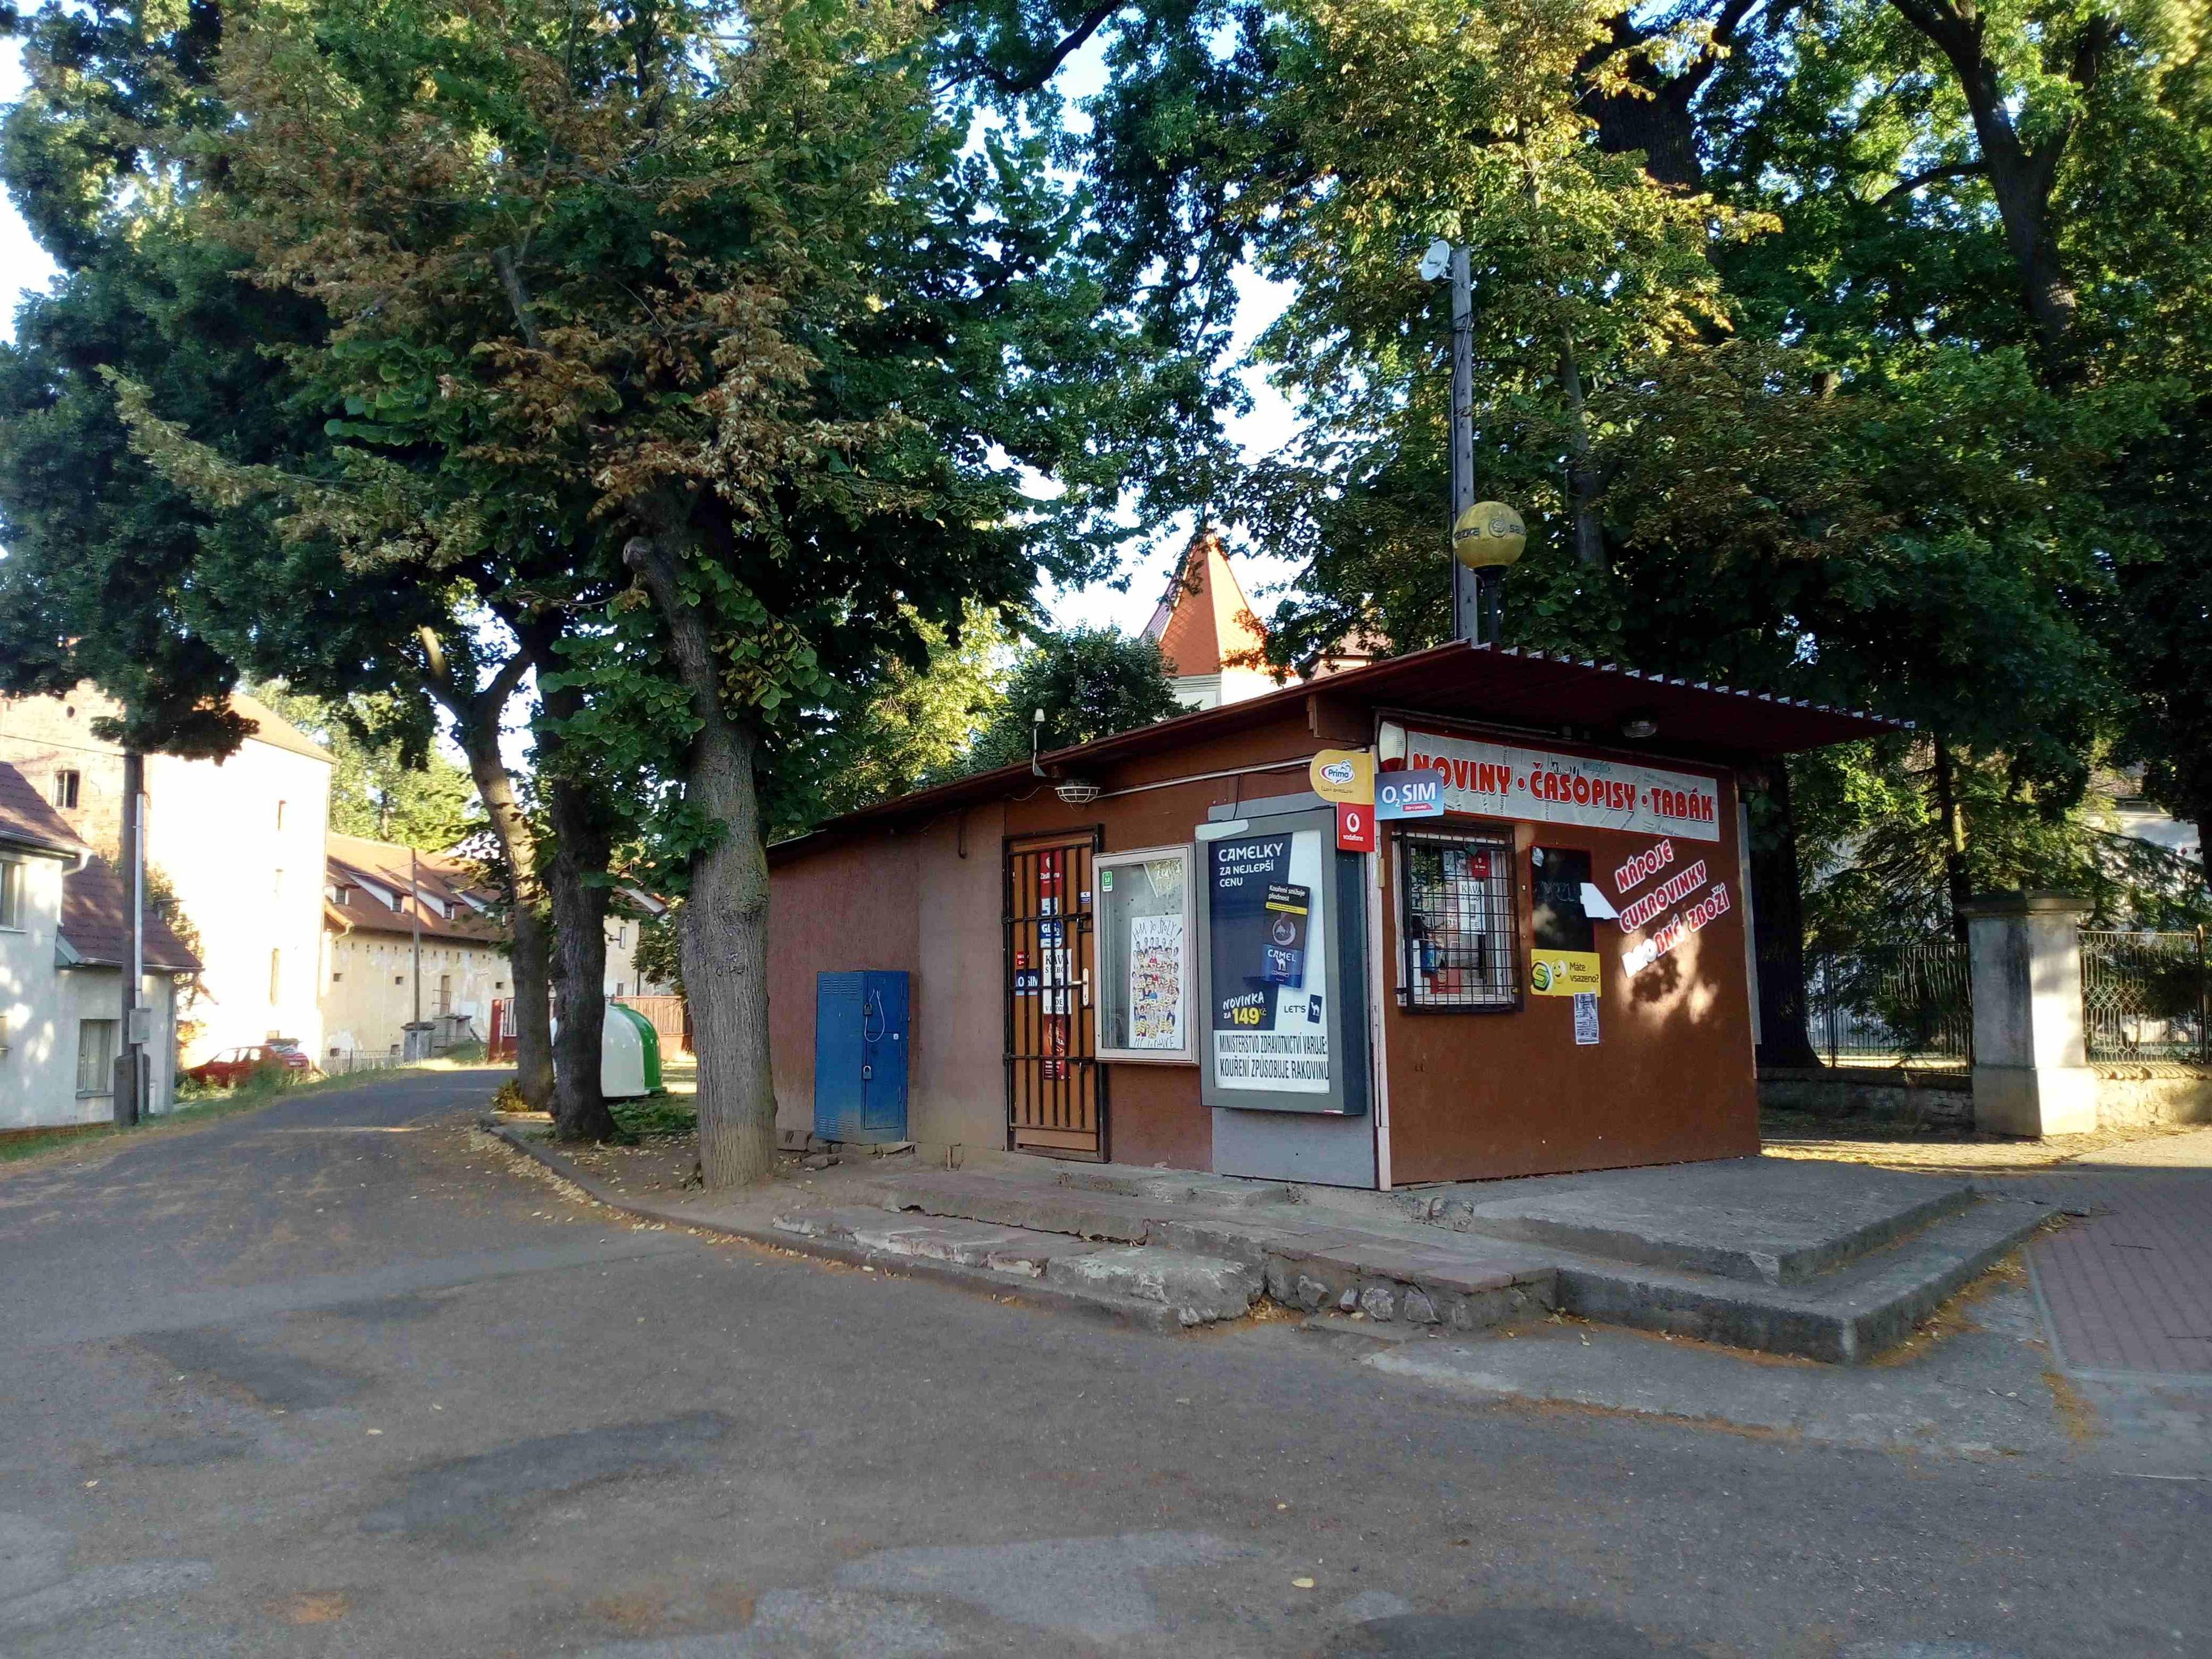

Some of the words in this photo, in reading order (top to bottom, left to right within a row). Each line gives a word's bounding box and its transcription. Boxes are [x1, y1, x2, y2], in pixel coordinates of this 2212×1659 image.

[1328, 769, 1349, 778] Prima
[1402, 782, 1436, 802] SIM
[1529, 761, 1636, 812] ČASOPISY
[1651, 787, 1714, 823] TABÁK
[1218, 842, 1283, 862] CAMELKY
[1219, 867, 1230, 875] ZA
[1233, 860, 1274, 875] NEJLEPŠÍ
[1615, 839, 1674, 894] NÁPOJE
[1219, 877, 1243, 888] CENU
[1620, 859, 1707, 933] CUKROVINKY
[1621, 913, 1684, 978] OBNÉ
[1686, 883, 1730, 932] ZBOŽÍ
[1267, 949, 1296, 962] CAMEL
[1569, 962, 1586, 972] Máte
[1570, 974, 1599, 983] vsazeno?
[1223, 992, 1264, 1010] NOVINKA
[1232, 1007, 1260, 1025] 149
[1219, 1035, 1259, 1053] MINISTERSTVO
[1261, 1032, 1302, 1054] ZDRAVOTNICTVÍ
[1220, 1055, 1249, 1077] KOUŘENÍ
[1251, 1055, 1289, 1078] ZPŮSOBUJE
[1291, 1060, 1329, 1079] RAKOVINU
